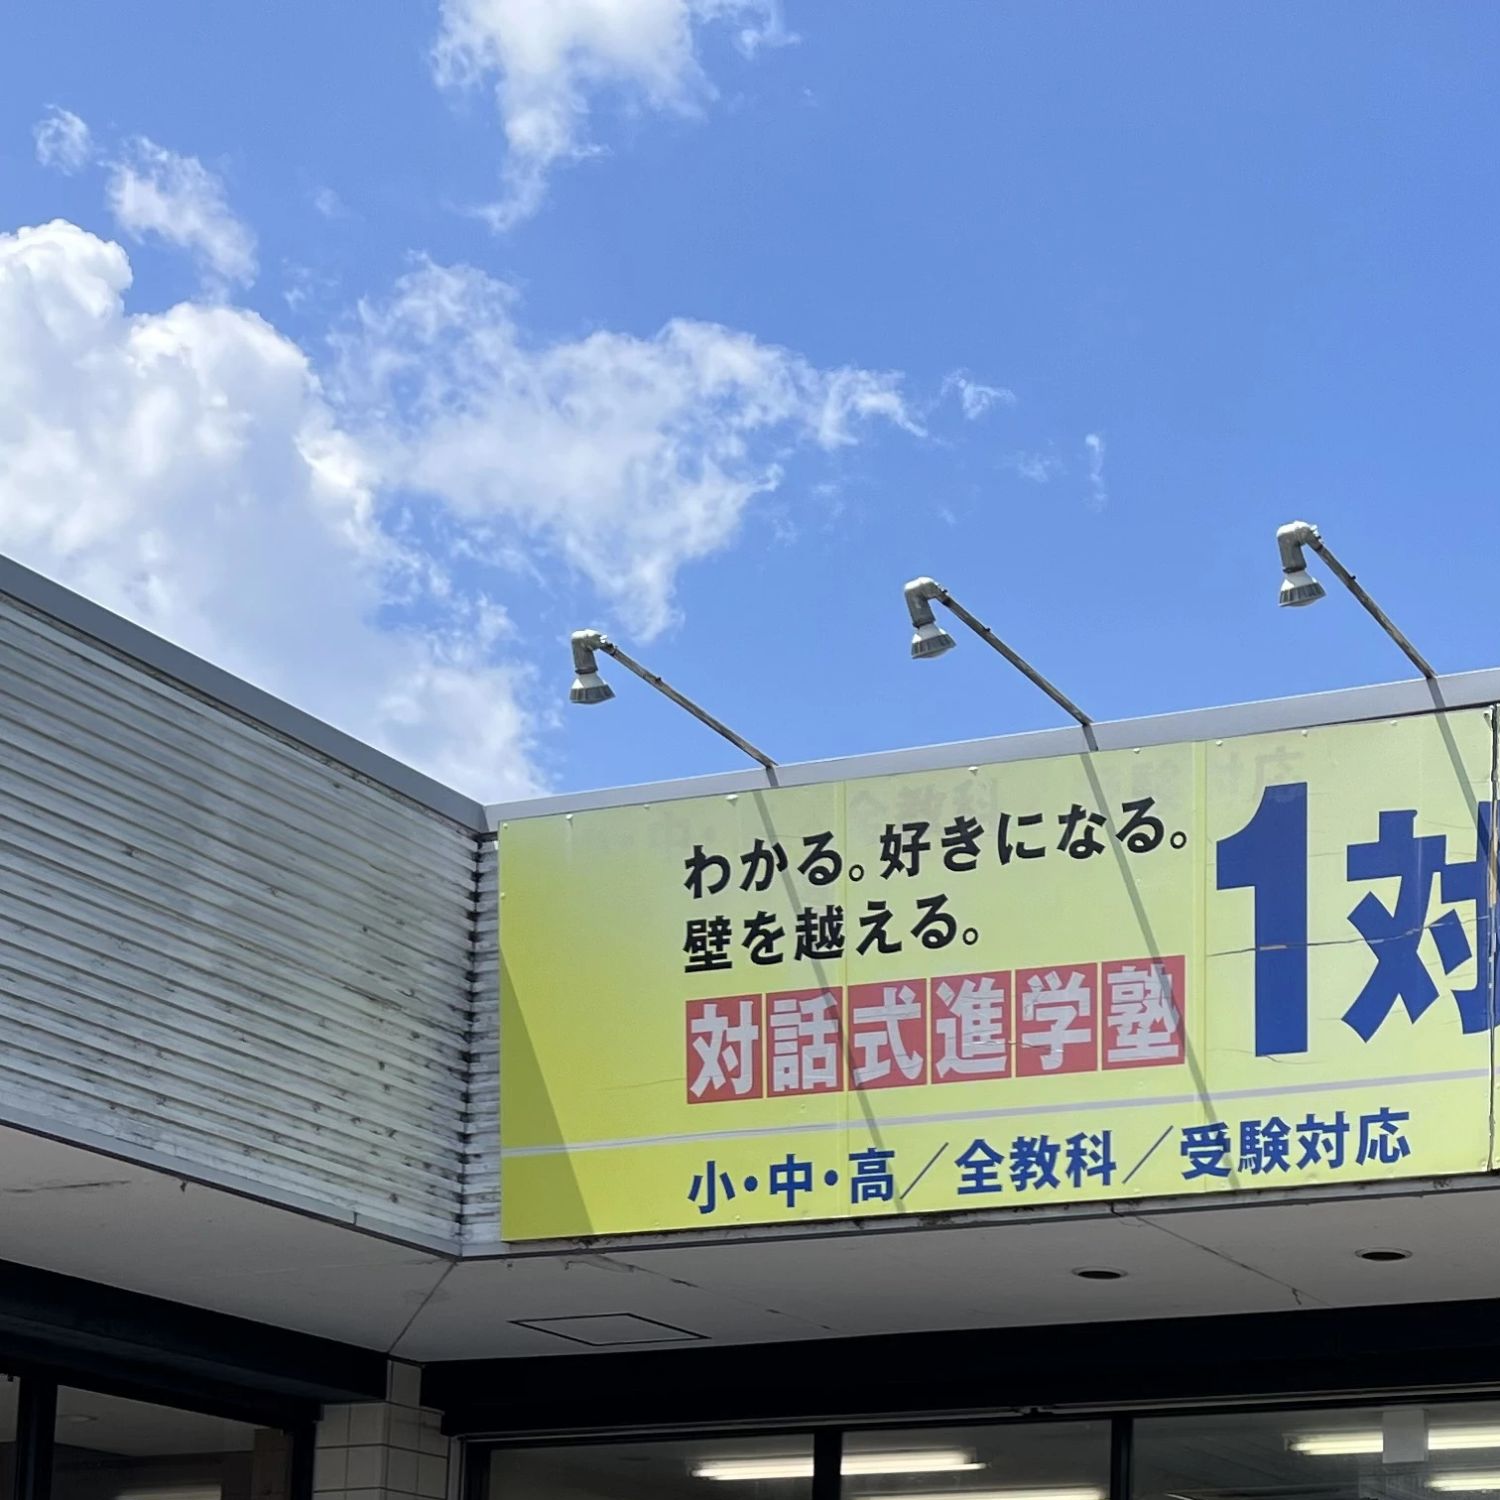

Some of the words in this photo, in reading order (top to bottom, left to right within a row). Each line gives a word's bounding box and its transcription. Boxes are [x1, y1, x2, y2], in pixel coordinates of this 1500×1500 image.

[684, 797, 1188, 899] わかる。好きになる。
[684, 894, 980, 973] 壁を越える。
[689, 964, 1182, 1099] 対話式進学塾
